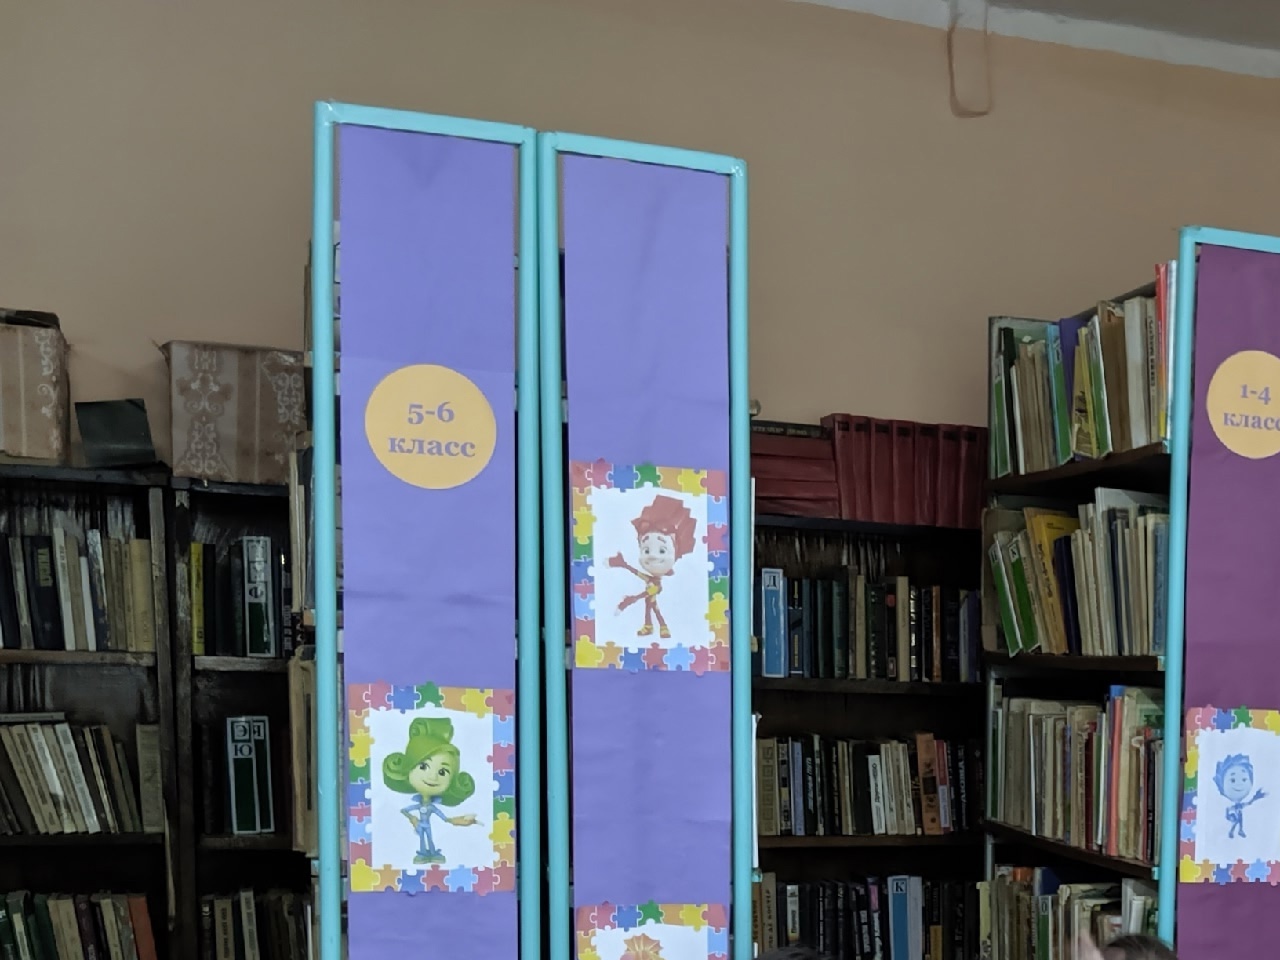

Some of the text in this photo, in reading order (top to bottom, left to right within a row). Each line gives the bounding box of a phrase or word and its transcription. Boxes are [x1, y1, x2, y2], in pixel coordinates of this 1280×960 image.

[1240, 384, 1271, 405] 1-4
[407, 401, 455, 425] 5-6
[388, 437, 476, 457] класс
[234, 744, 253, 757] Ю
